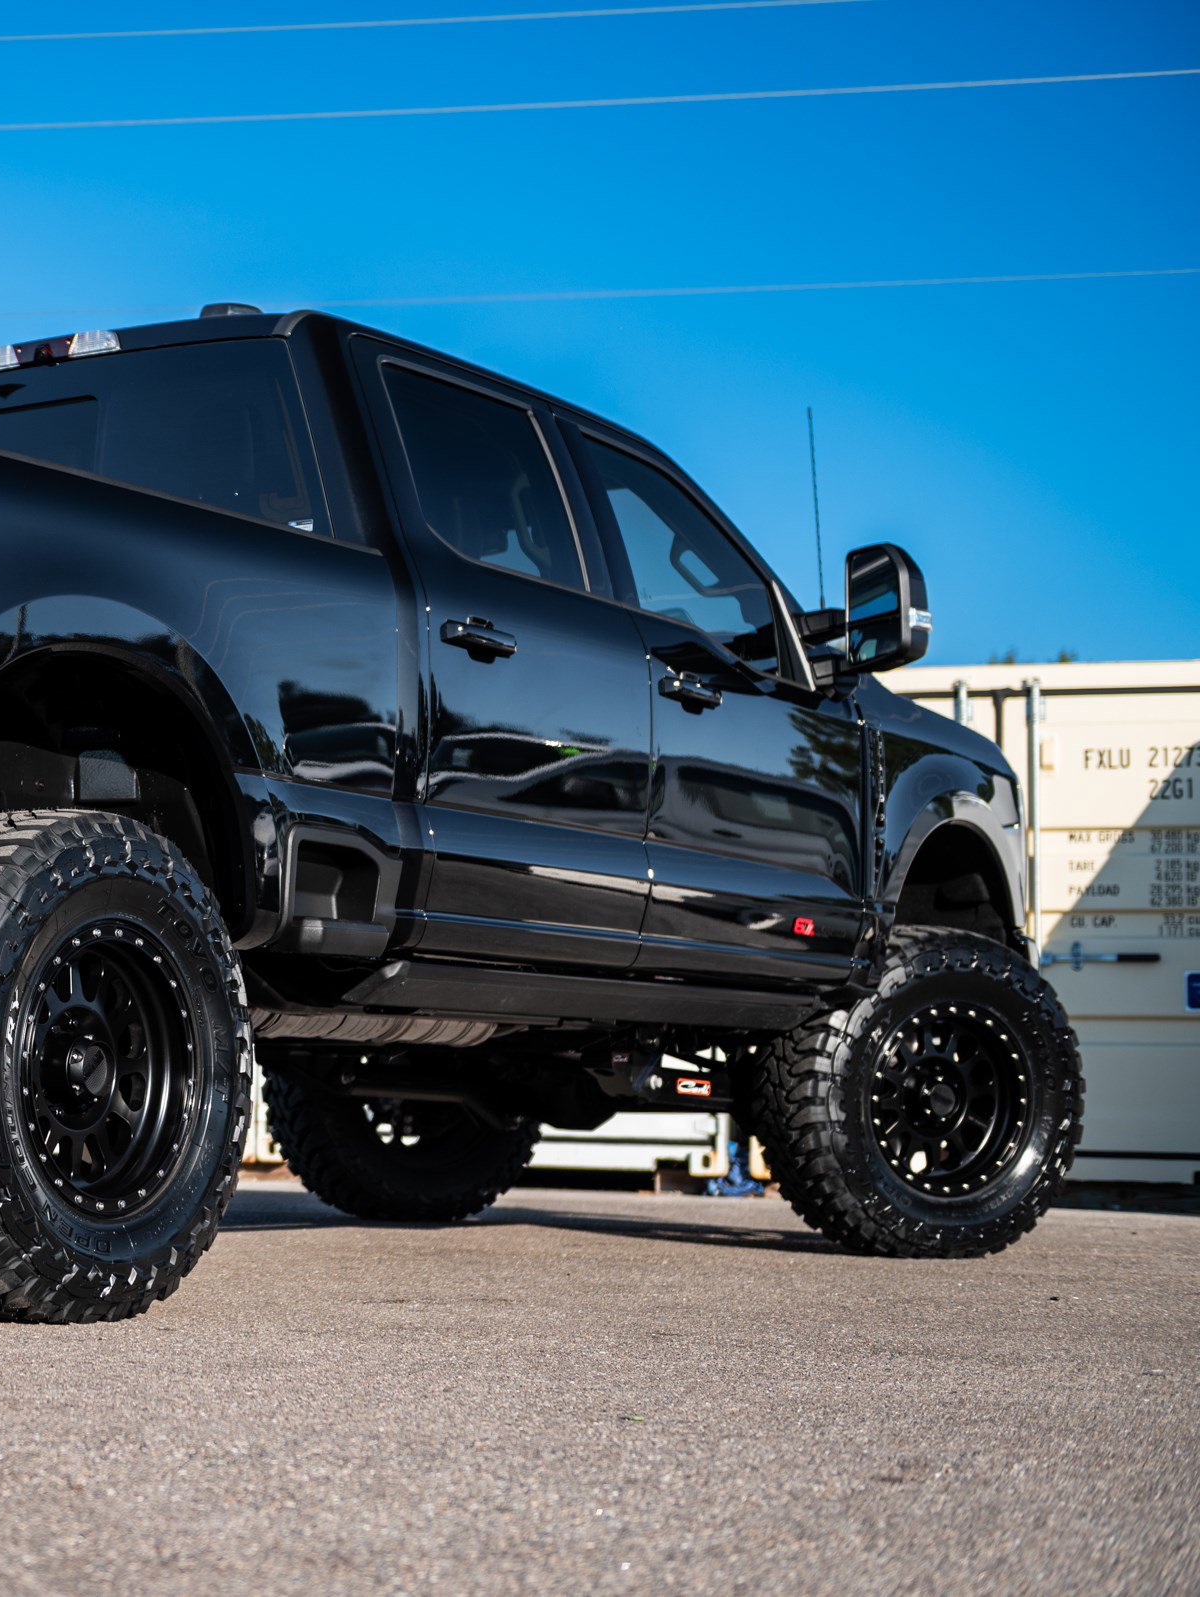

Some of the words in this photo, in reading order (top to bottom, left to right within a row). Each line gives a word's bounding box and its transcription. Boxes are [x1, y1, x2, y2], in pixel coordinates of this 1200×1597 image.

[1083, 747, 1131, 770] FXLU
[1147, 777, 1194, 801] 22G1
[1068, 830, 1091, 844] MAX
[1068, 860, 1096, 871] TARE
[1068, 883, 1121, 897] PAYLOAD
[156, 895, 220, 994] TOYO
[41, 1199, 112, 1256] OPEN
